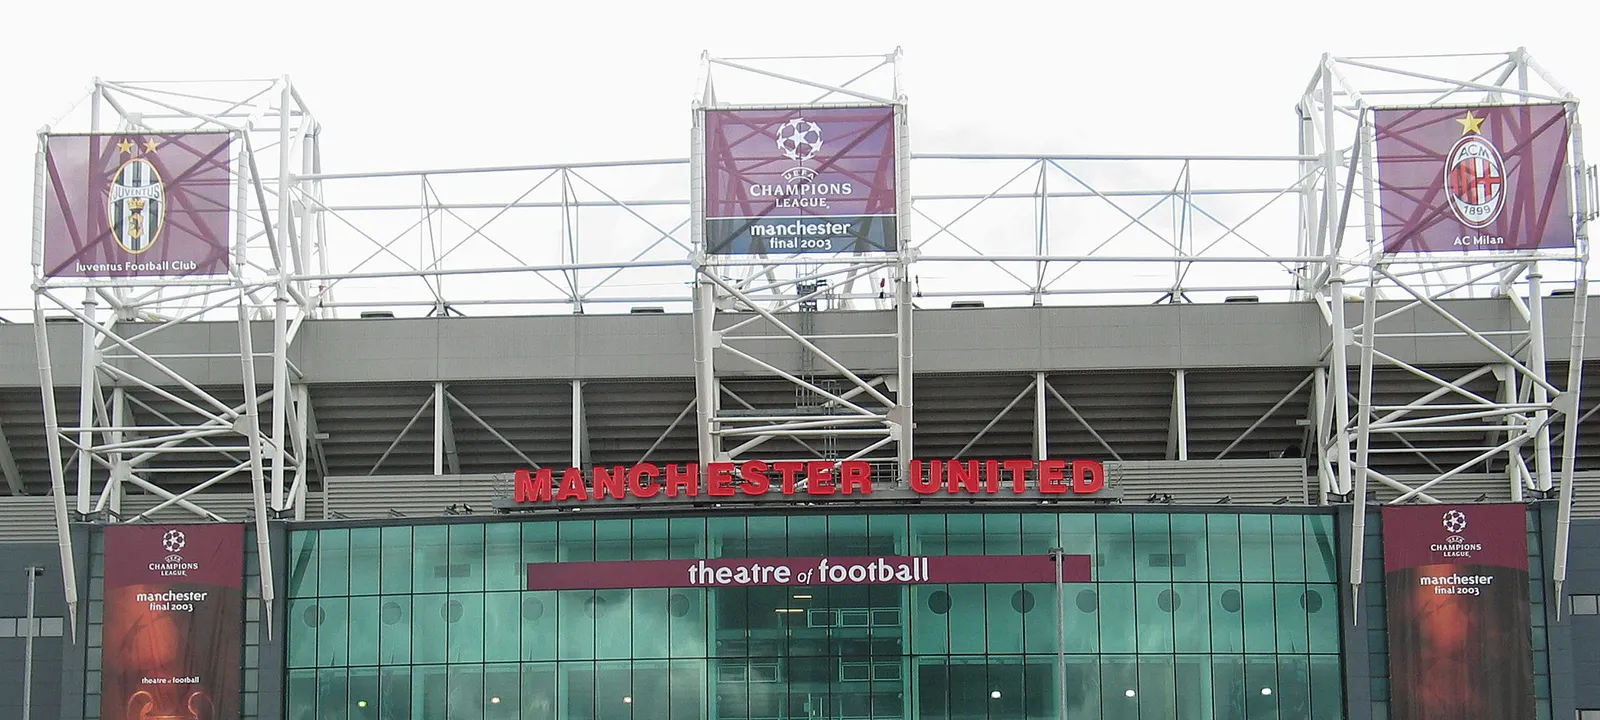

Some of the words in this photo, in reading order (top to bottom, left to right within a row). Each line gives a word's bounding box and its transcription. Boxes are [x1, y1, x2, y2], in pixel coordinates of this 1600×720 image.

[1458, 144, 1490, 159] ACM
[784, 169, 815, 181] UEFA
[113, 183, 161, 201] JUVENTUS
[750, 183, 852, 196] CHAMPIONS
[1463, 205, 1491, 216] 1899
[751, 220, 851, 236] manchester
[770, 237, 798, 249] final
[800, 239, 832, 250] 2003
[1453, 236, 1471, 246] AC
[1473, 235, 1504, 245] Milan
[76, 262, 123, 272] Juventus
[125, 261, 169, 271] Football
[172, 260, 197, 271] Club
[514, 460, 873, 503] MANCHESTER
[910, 459, 1105, 494] UNITED
[1430, 543, 1482, 551] CHAMPIONS
[149, 562, 199, 570] CHAMPIONS
[688, 561, 790, 584] theatre
[797, 568, 813, 585] of
[818, 557, 929, 582] football
[1420, 574, 1494, 585] manchester
[136, 590, 207, 602] manchester
[1434, 586, 1455, 594] final
[1457, 587, 1480, 595] 2003
[150, 603, 170, 611] final
[171, 603, 194, 612] 2003
[141, 676, 166, 684] theatre
[172, 676, 199, 684] football
